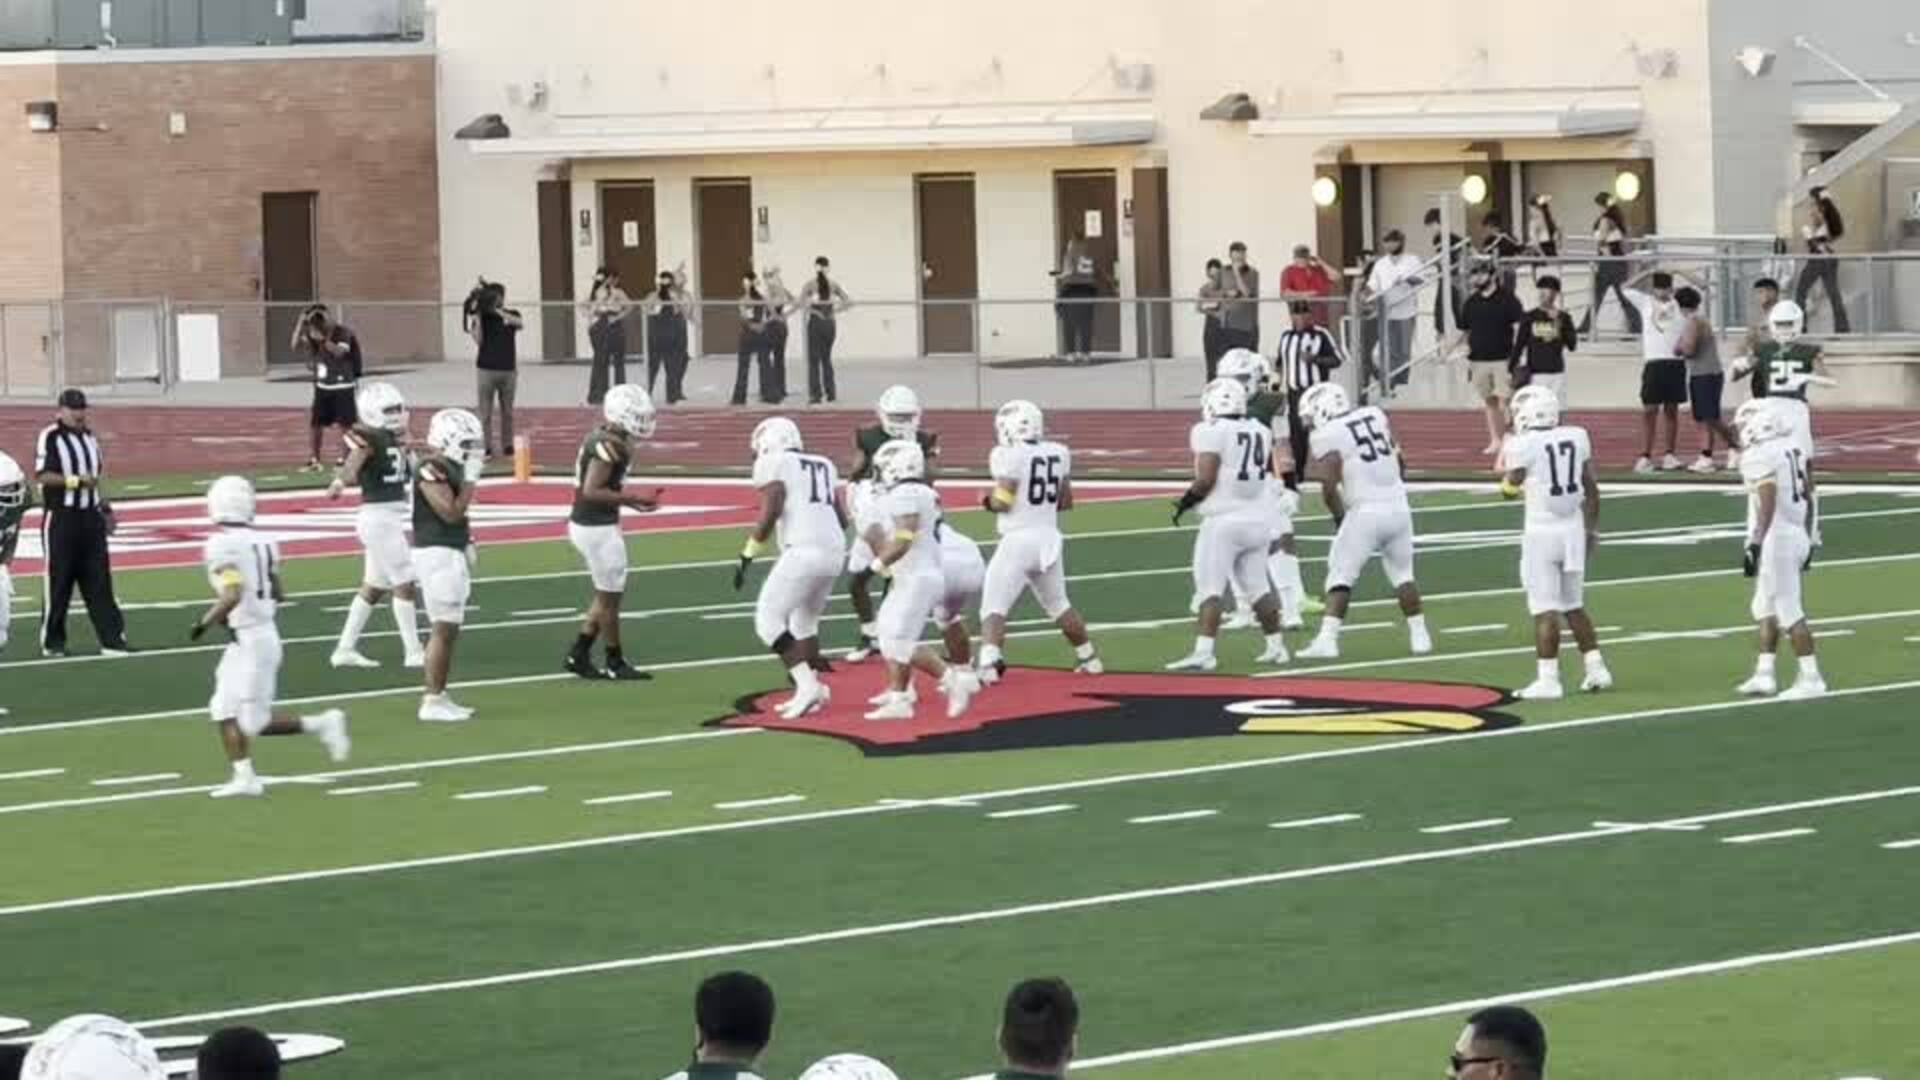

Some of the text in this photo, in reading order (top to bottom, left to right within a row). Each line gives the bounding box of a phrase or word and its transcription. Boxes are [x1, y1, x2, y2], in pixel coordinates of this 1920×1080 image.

[1769, 361, 1804, 391] 25
[1346, 415, 1393, 462] 55
[1028, 455, 1061, 505] 65
[1545, 441, 1578, 496] 17
